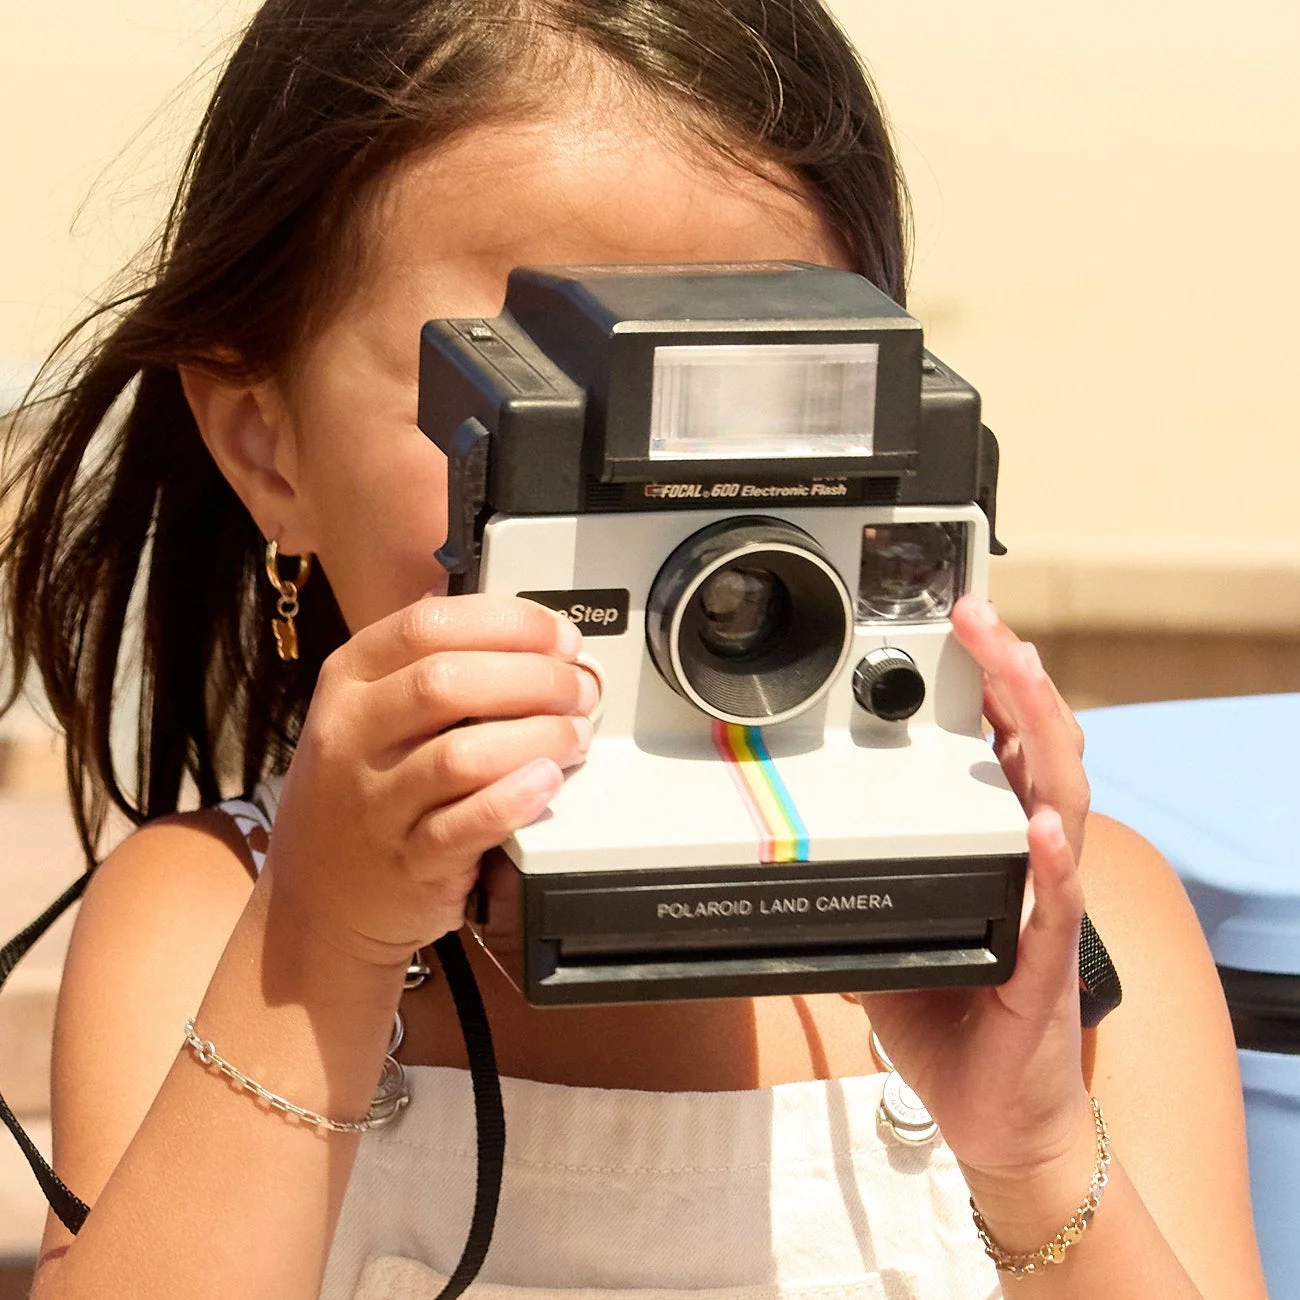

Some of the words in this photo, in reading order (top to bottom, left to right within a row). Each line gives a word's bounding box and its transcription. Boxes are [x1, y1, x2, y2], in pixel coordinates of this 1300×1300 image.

[711, 483, 740, 498] 600
[741, 484, 810, 498] Electronic
[811, 483, 848, 497] Flash
[657, 900, 752, 919] POLAROID
[760, 897, 809, 915] LAND
[816, 894, 893, 912] CAMERA
